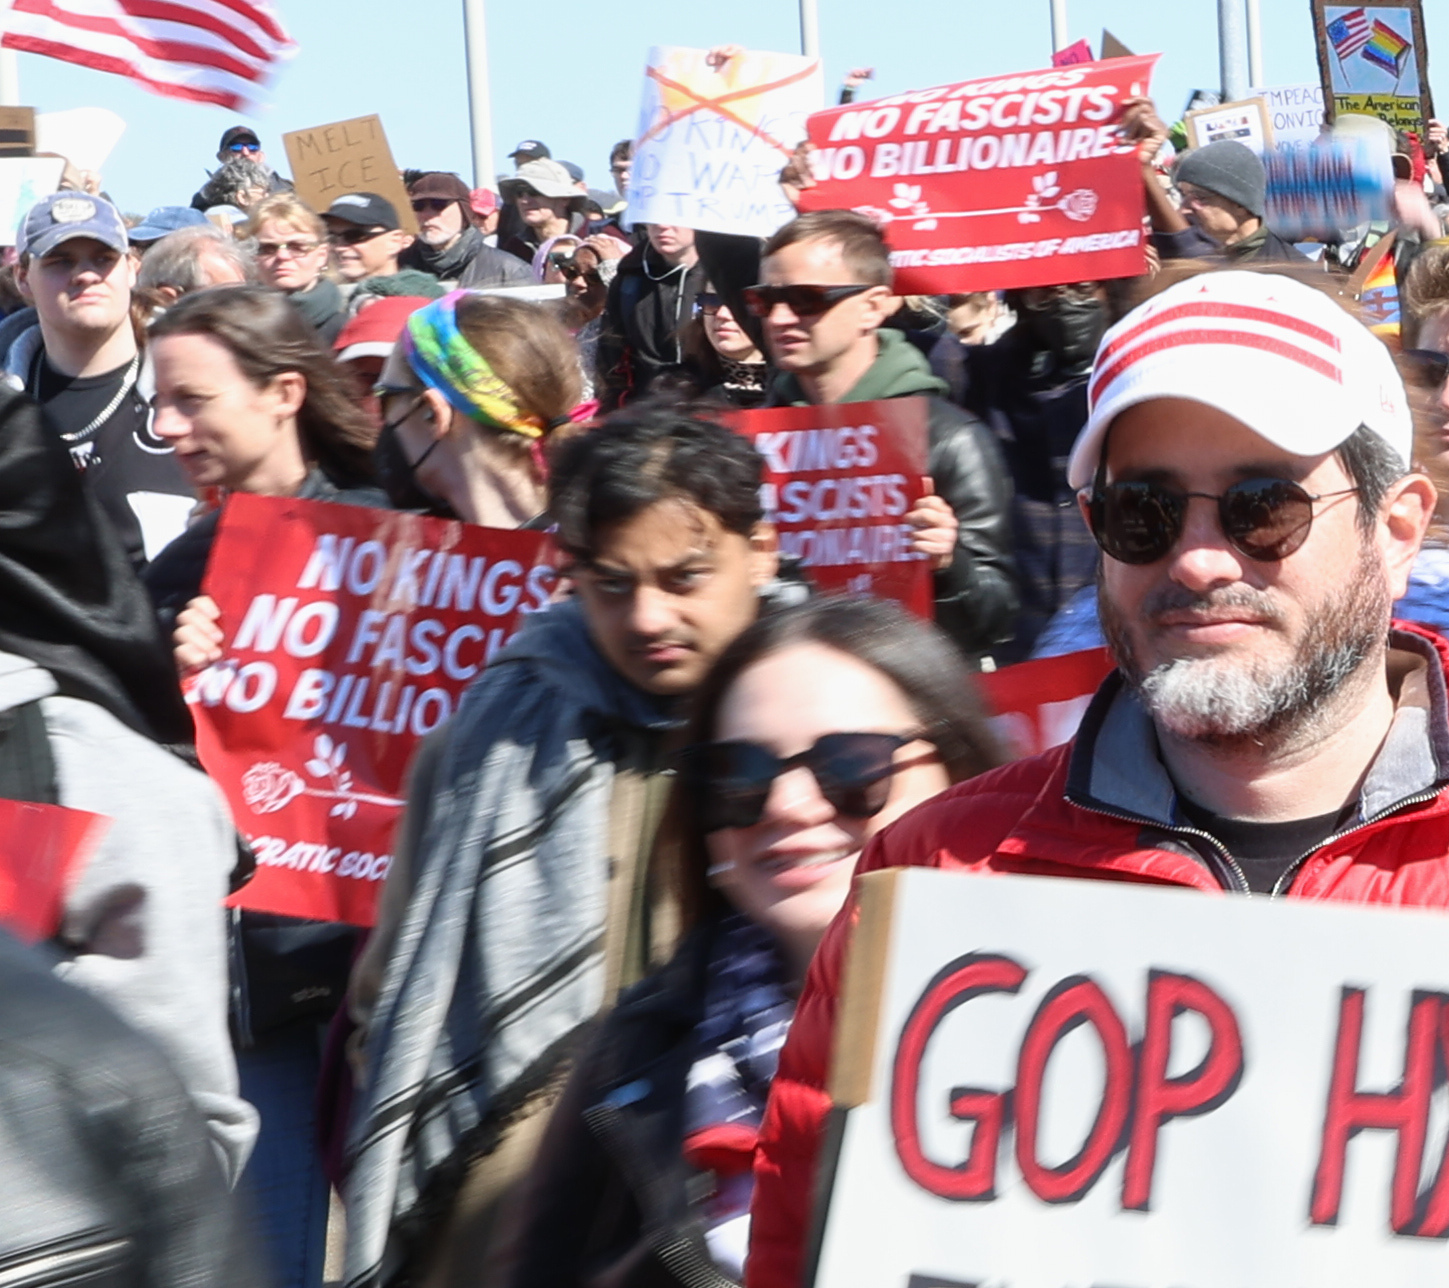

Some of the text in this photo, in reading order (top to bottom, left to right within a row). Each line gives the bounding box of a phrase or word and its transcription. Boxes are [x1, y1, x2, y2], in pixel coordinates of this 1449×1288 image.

[950, 68, 1093, 98] KINGS
[1335, 95, 1420, 112] The American
[829, 86, 1119, 141] NO FASCISTS
[295, 118, 377, 162] MELT
[308, 155, 380, 194] ICE
[812, 147, 865, 181] NO
[755, 424, 879, 474] KINGS
[298, 533, 556, 616] NO KINGS
[231, 593, 517, 681] NO FASCI
[185, 658, 466, 736] NO BILLIO
[246, 834, 338, 875] CRATIC
[890, 952, 1248, 1215] GOP
